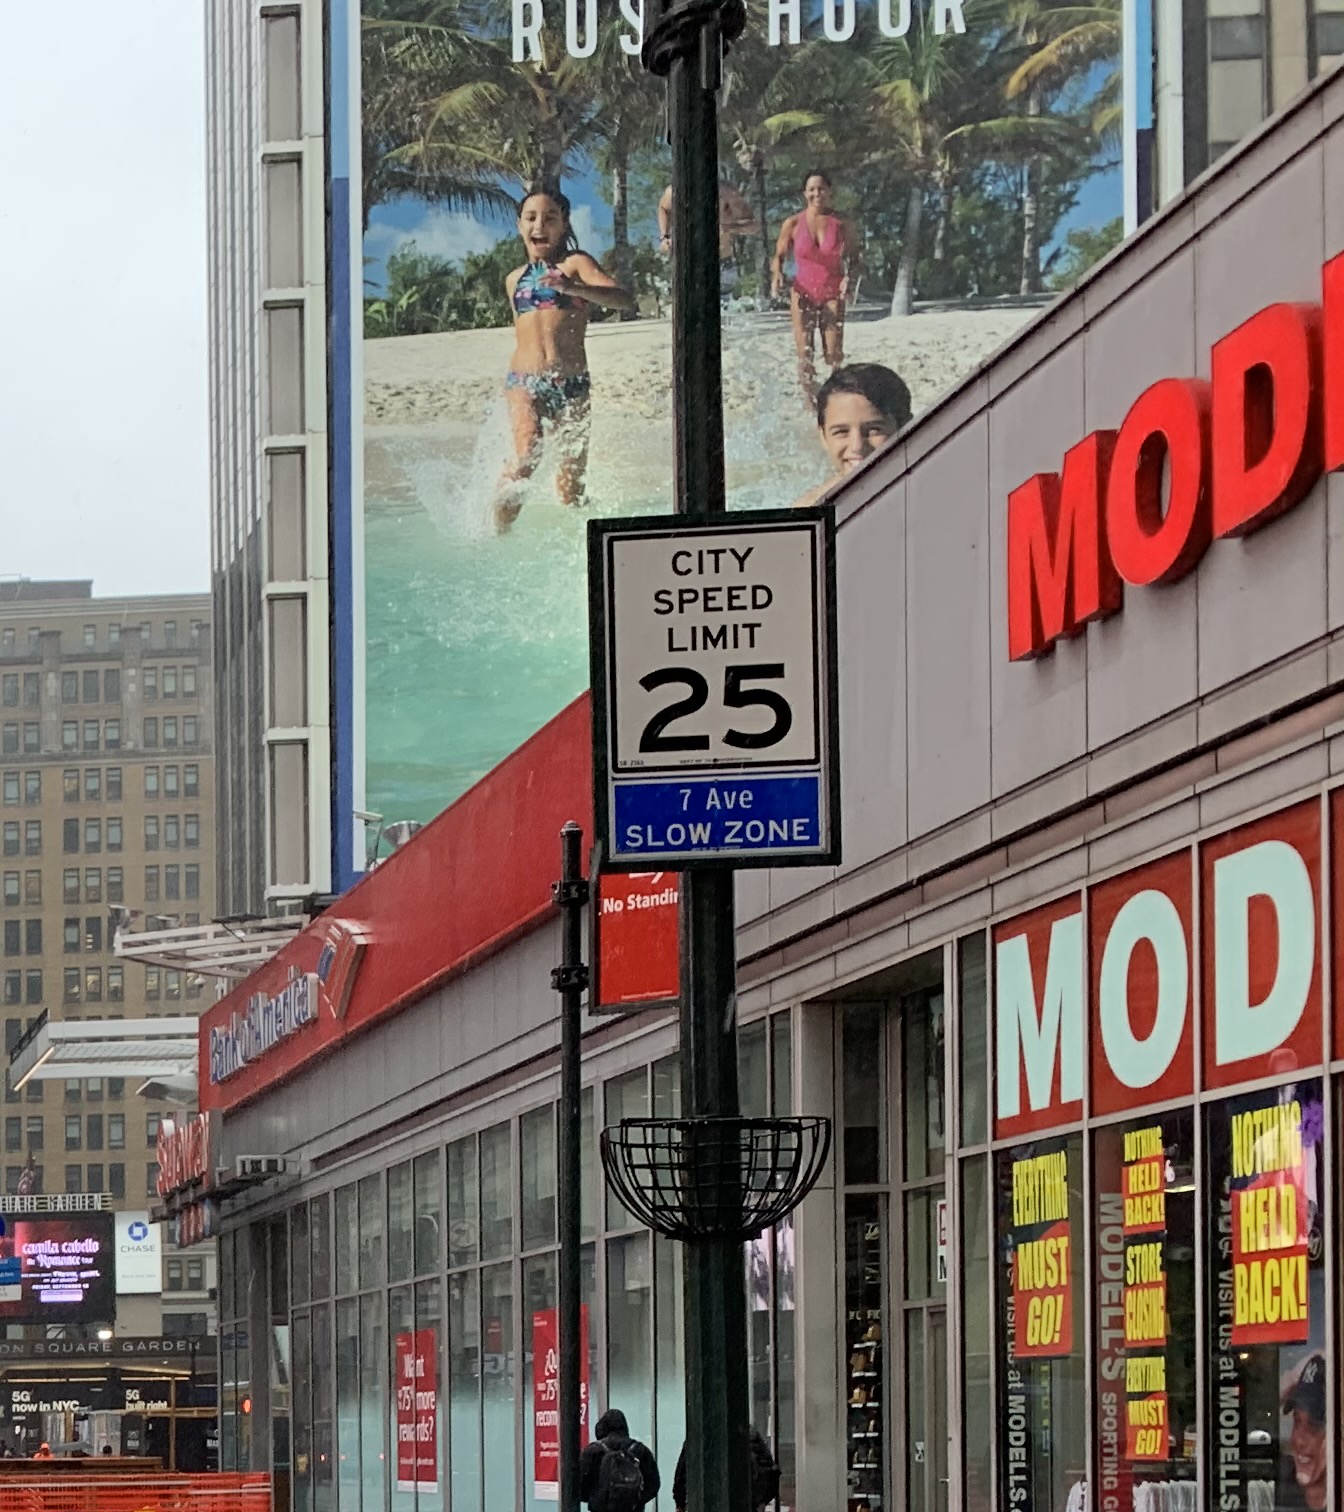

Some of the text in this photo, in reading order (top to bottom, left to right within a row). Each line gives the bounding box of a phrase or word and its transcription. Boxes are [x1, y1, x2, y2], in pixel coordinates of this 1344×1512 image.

[512, 0, 644, 63] RUS
[1007, 249, 1344, 663] MOD
[671, 546, 755, 576] CITY
[653, 584, 774, 616] SPEED
[667, 622, 762, 653] LIMIT
[638, 662, 794, 754] 25
[679, 787, 754, 811] 7 Ave
[625, 817, 811, 848] SLOW ZONE
[602, 887, 679, 914] No Standi
[995, 839, 1316, 1121] MOD
[210, 1012, 243, 1084] Bank
[256, 966, 315, 1053] America
[1124, 1125, 1163, 1163] NOTHING
[1231, 1100, 1303, 1178] NOTHING
[1012, 1150, 1069, 1227] EVERYTHING
[1127, 1160, 1161, 1195] HELD
[1124, 1192, 1165, 1228] BACK!
[1239, 1184, 1298, 1254] HELD
[21, 1237, 100, 1254] camila cabello
[120, 1245, 156, 1253] CHASE
[1017, 1235, 1069, 1292] MUST
[1125, 1242, 1163, 1287] STORE
[1099, 1192, 1126, 1382] MODELL'S
[1234, 1255, 1308, 1327] BACK!
[1026, 1294, 1064, 1348] GO!
[1124, 1285, 1165, 1342] CLOSING
[34, 1341, 113, 1354] SQUARE
[122, 1340, 201, 1352] GARDEN
[1007, 1370, 1025, 1390] at
[1125, 1355, 1166, 1393] EVERYTHING
[1219, 1354, 1236, 1380] at
[12, 1390, 32, 1402] 5G
[12, 1400, 80, 1412] now in NYC
[125, 1389, 141, 1400] 5G
[416, 1391, 436, 1410] more
[1127, 1399, 1165, 1427] MUST
[1102, 1391, 1119, 1491] SPORTING
[1134, 1427, 1162, 1456] GO!
